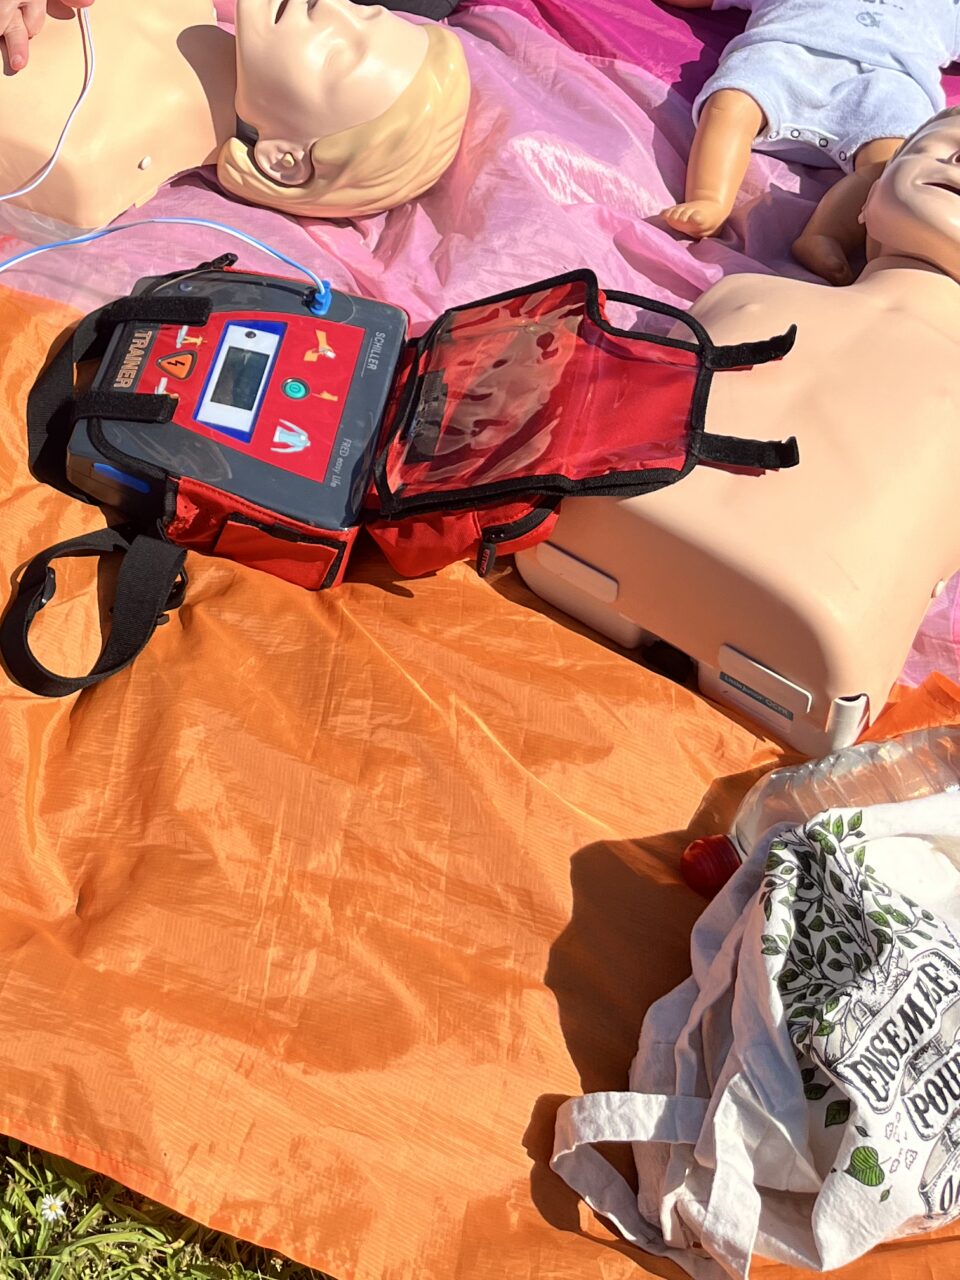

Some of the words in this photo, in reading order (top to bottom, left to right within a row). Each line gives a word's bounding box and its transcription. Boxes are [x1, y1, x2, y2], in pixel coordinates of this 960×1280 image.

[113, 329, 153, 388] TRAINER
[367, 331, 386, 370] SCHILLER
[339, 437, 352, 457] FRED
